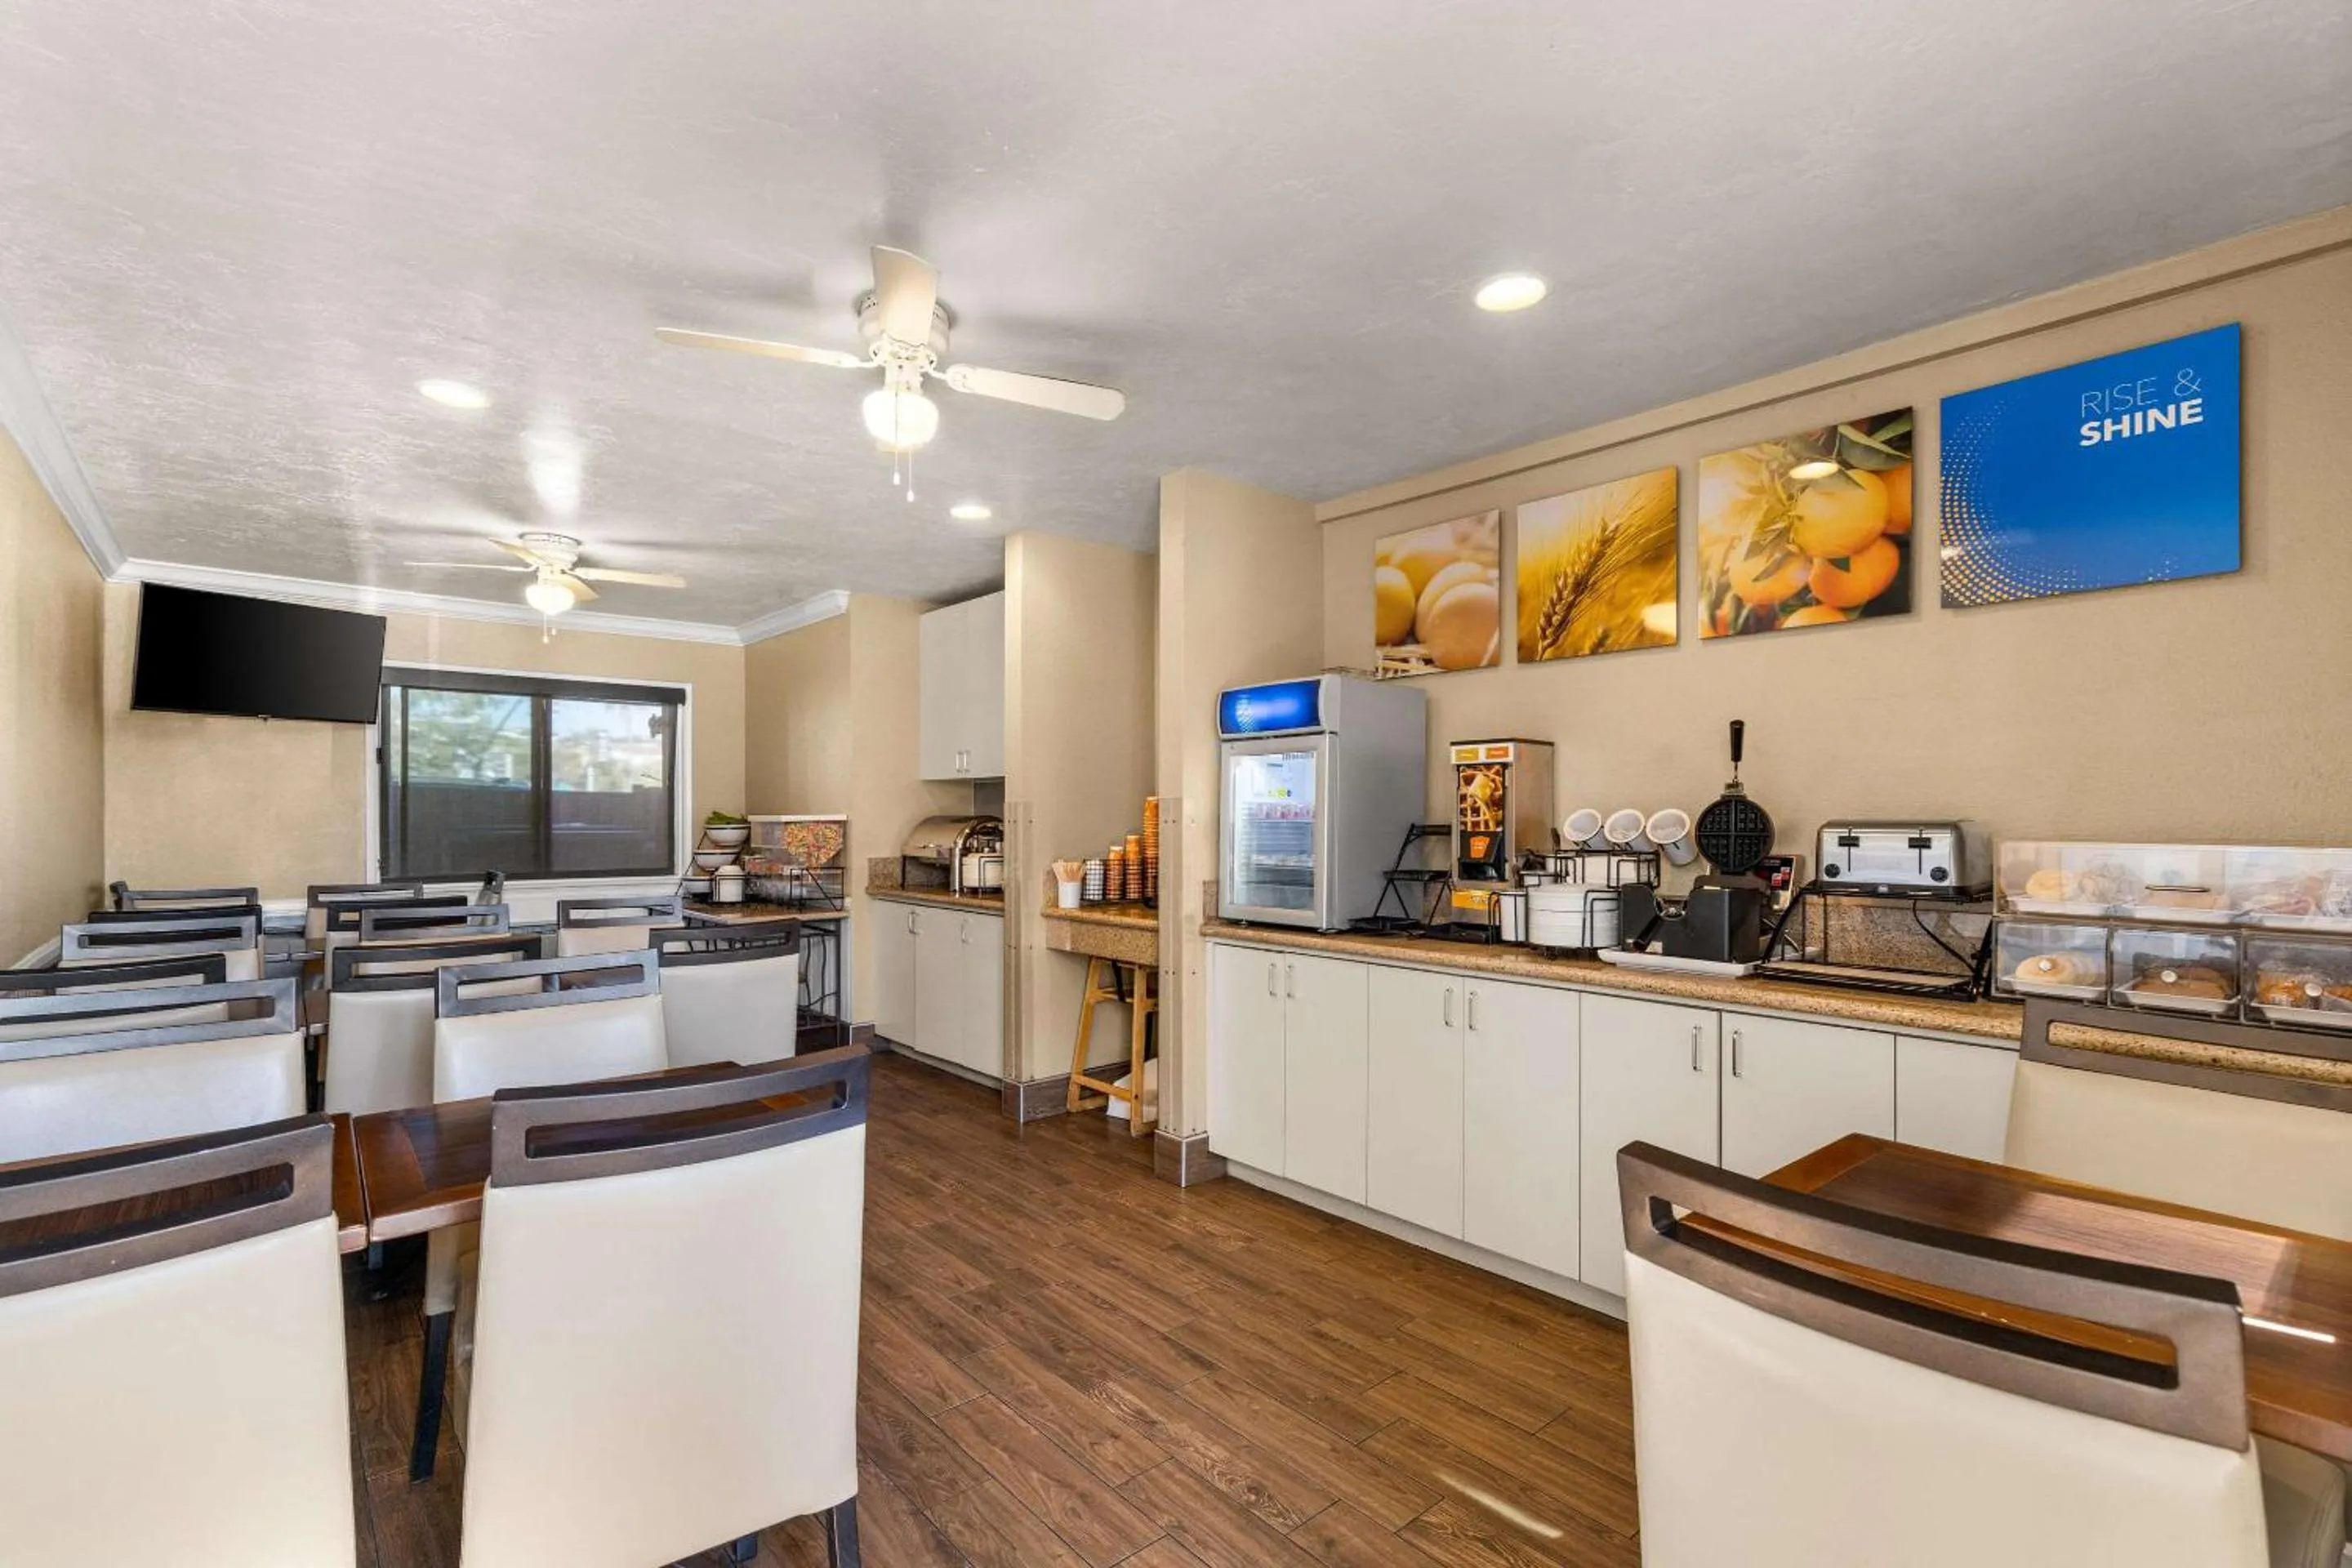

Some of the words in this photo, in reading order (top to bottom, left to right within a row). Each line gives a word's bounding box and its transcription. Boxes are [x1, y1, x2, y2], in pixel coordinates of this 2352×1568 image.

[2082, 376, 2158, 419] RISE
[2174, 368, 2202, 397] &
[2079, 398, 2203, 447] SHINE
